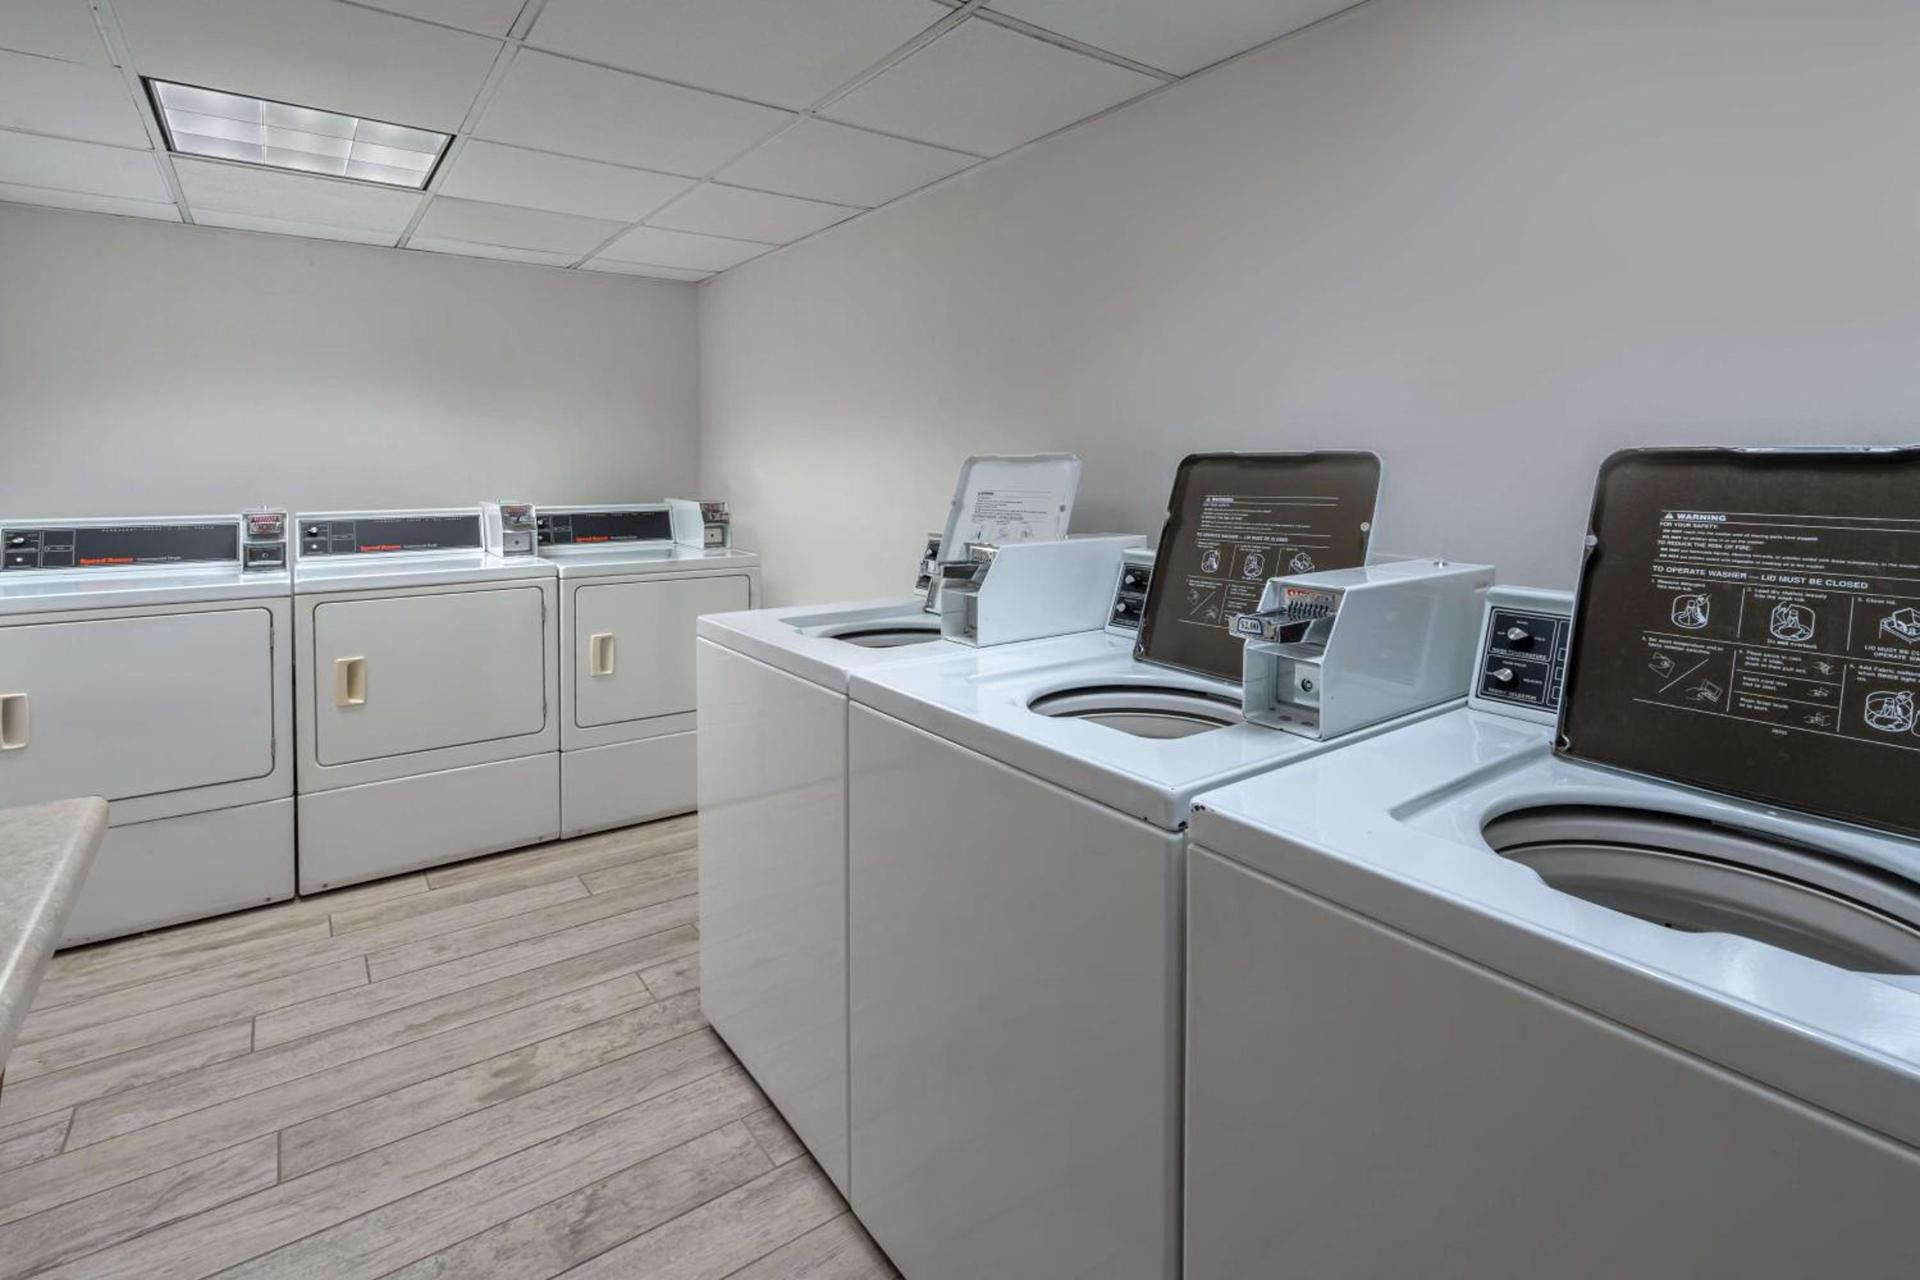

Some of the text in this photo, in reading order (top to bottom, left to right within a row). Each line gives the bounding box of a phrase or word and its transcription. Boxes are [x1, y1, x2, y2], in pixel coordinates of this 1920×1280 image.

[1677, 513, 1727, 522] WARNING
[1652, 565, 1664, 573] TO
[1665, 566, 1706, 576] OPERATE
[1708, 569, 1748, 580] WASHER
[1761, 574, 1777, 583] LID
[1778, 575, 1806, 585] MUST
[1808, 578, 1823, 586] BE
[1825, 579, 1869, 590] CLOSED
